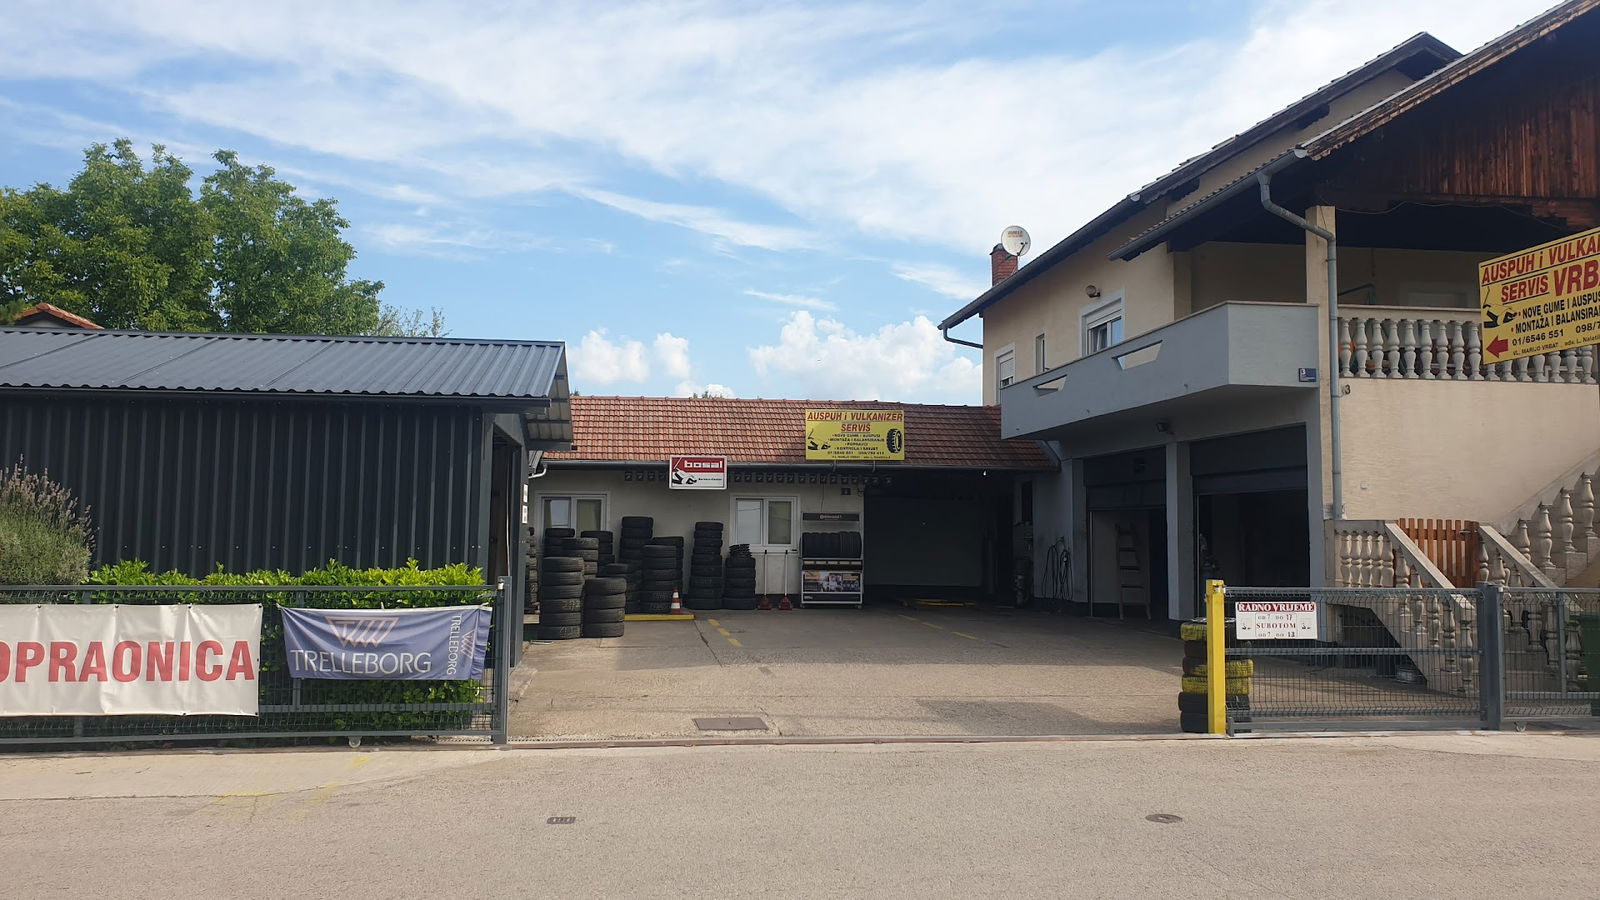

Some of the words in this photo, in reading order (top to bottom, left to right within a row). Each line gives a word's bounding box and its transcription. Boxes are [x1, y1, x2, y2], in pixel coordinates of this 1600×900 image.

[1482, 254, 1535, 284] AUSPUH
[1539, 252, 1544, 268] i
[1501, 275, 1548, 303] SERVIS
[1553, 259, 1600, 296] VRB
[1522, 308, 1542, 319] NOVE
[1544, 300, 1565, 316] GUME
[1515, 316, 1550, 334] MONTAŽA
[1512, 332, 1546, 346] 01/6546
[1548, 328, 1564, 339] 551
[807, 412, 842, 421] AUSPUH
[850, 412, 903, 421] VULKANIZER
[841, 423, 871, 432] SERVIS
[1238, 603, 1271, 612] RADNO
[1273, 603, 1314, 612] VRIJEME
[446, 615, 463, 675] TRELLEBORG
[290, 650, 431, 674] TRELLEBORG
